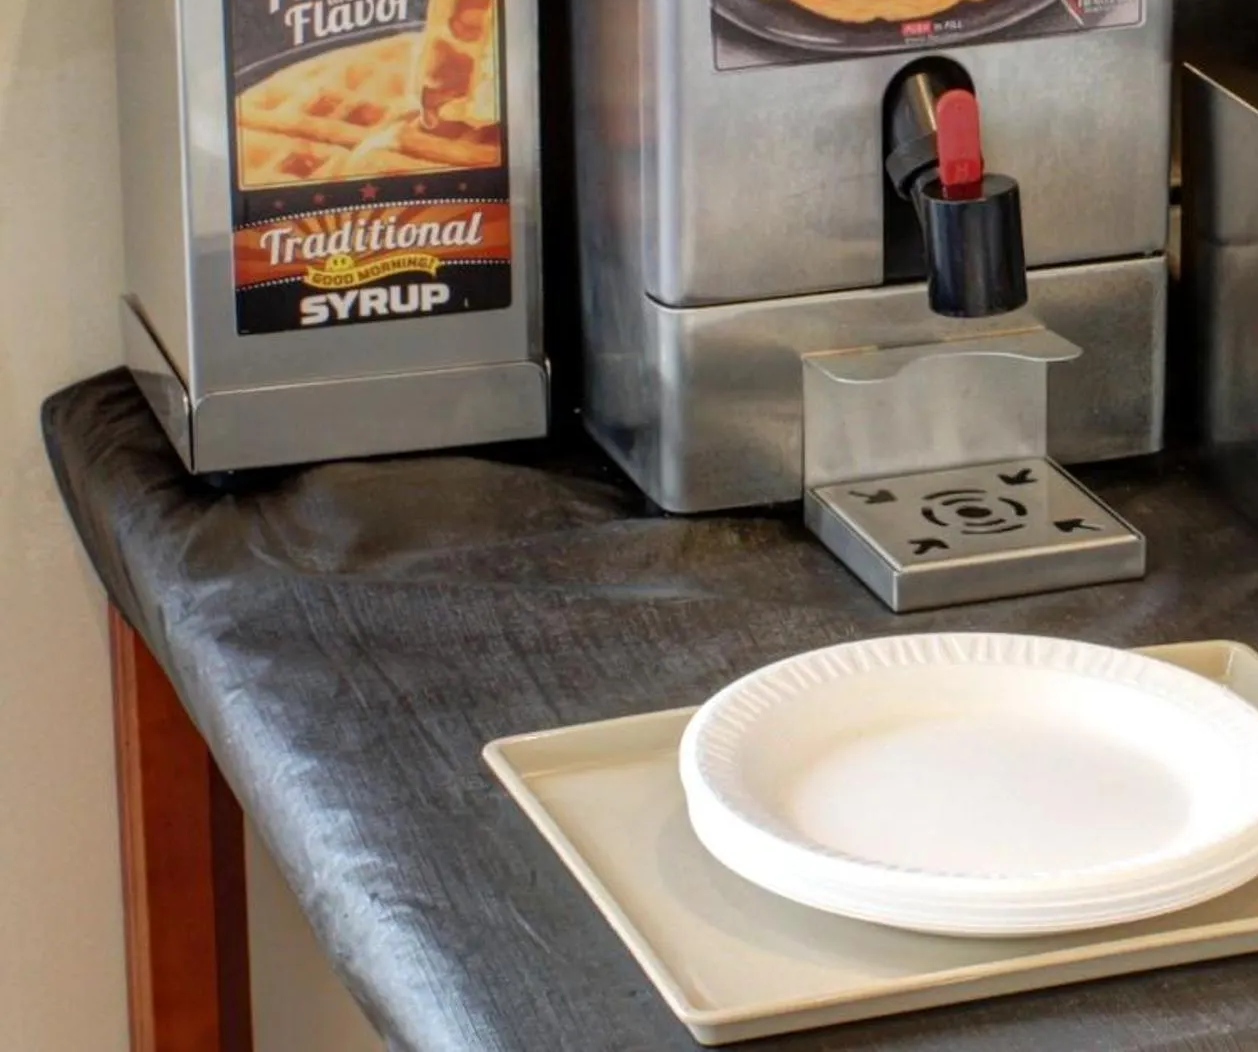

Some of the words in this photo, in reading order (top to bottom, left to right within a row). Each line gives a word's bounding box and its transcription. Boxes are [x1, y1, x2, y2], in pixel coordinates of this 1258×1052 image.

[259, 211, 484, 267] Traditional
[311, 269, 355, 285] GOOD
[356, 254, 436, 281] MORNING!
[299, 283, 451, 326] SYRUP
